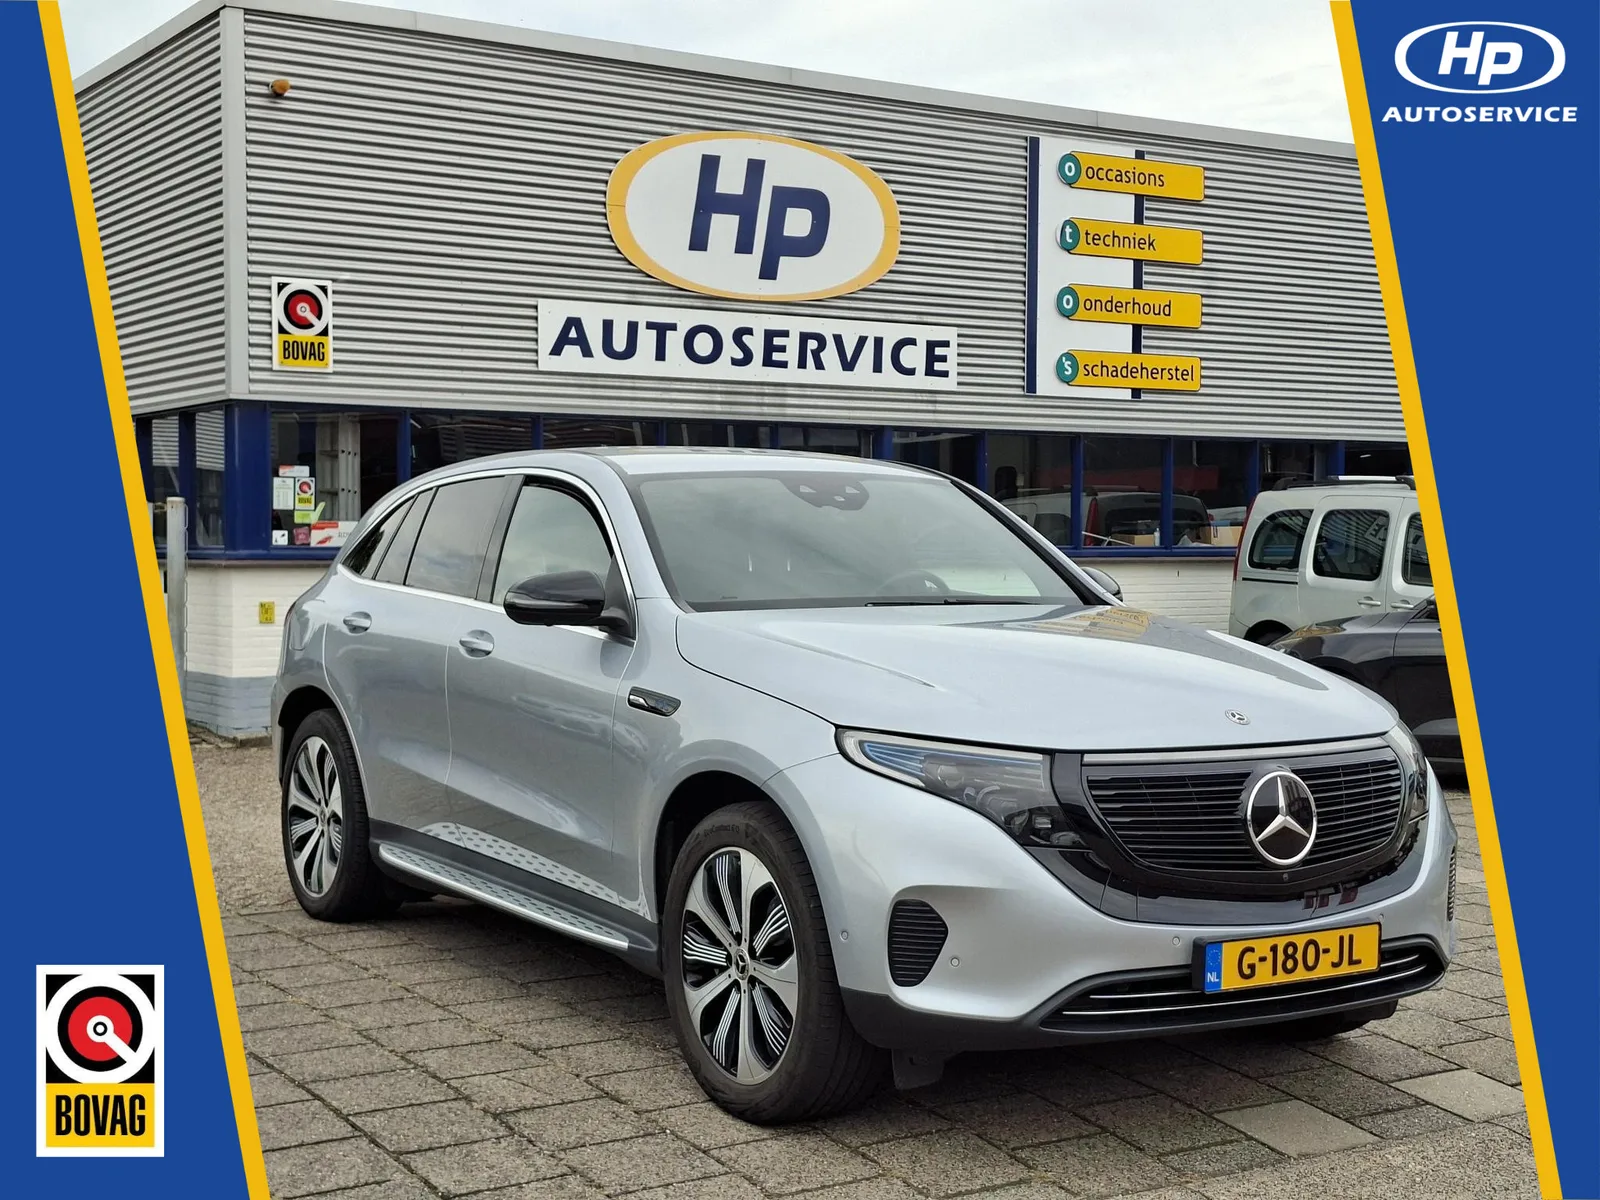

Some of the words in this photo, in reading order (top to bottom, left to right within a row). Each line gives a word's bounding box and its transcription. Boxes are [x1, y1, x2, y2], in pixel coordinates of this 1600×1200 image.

[1085, 166, 1165, 187] occasions
[688, 153, 831, 281] Hp
[1064, 225, 1073, 243] t
[1084, 230, 1156, 251] techniek
[1083, 295, 1172, 317] onderhoud
[282, 340, 326, 362] BOVAG
[548, 316, 951, 378] AUTOSERVICE
[1083, 360, 1194, 382] schadeherstel
[1207, 972, 1220, 983] NL
[1237, 934, 1362, 980] G-180-JL
